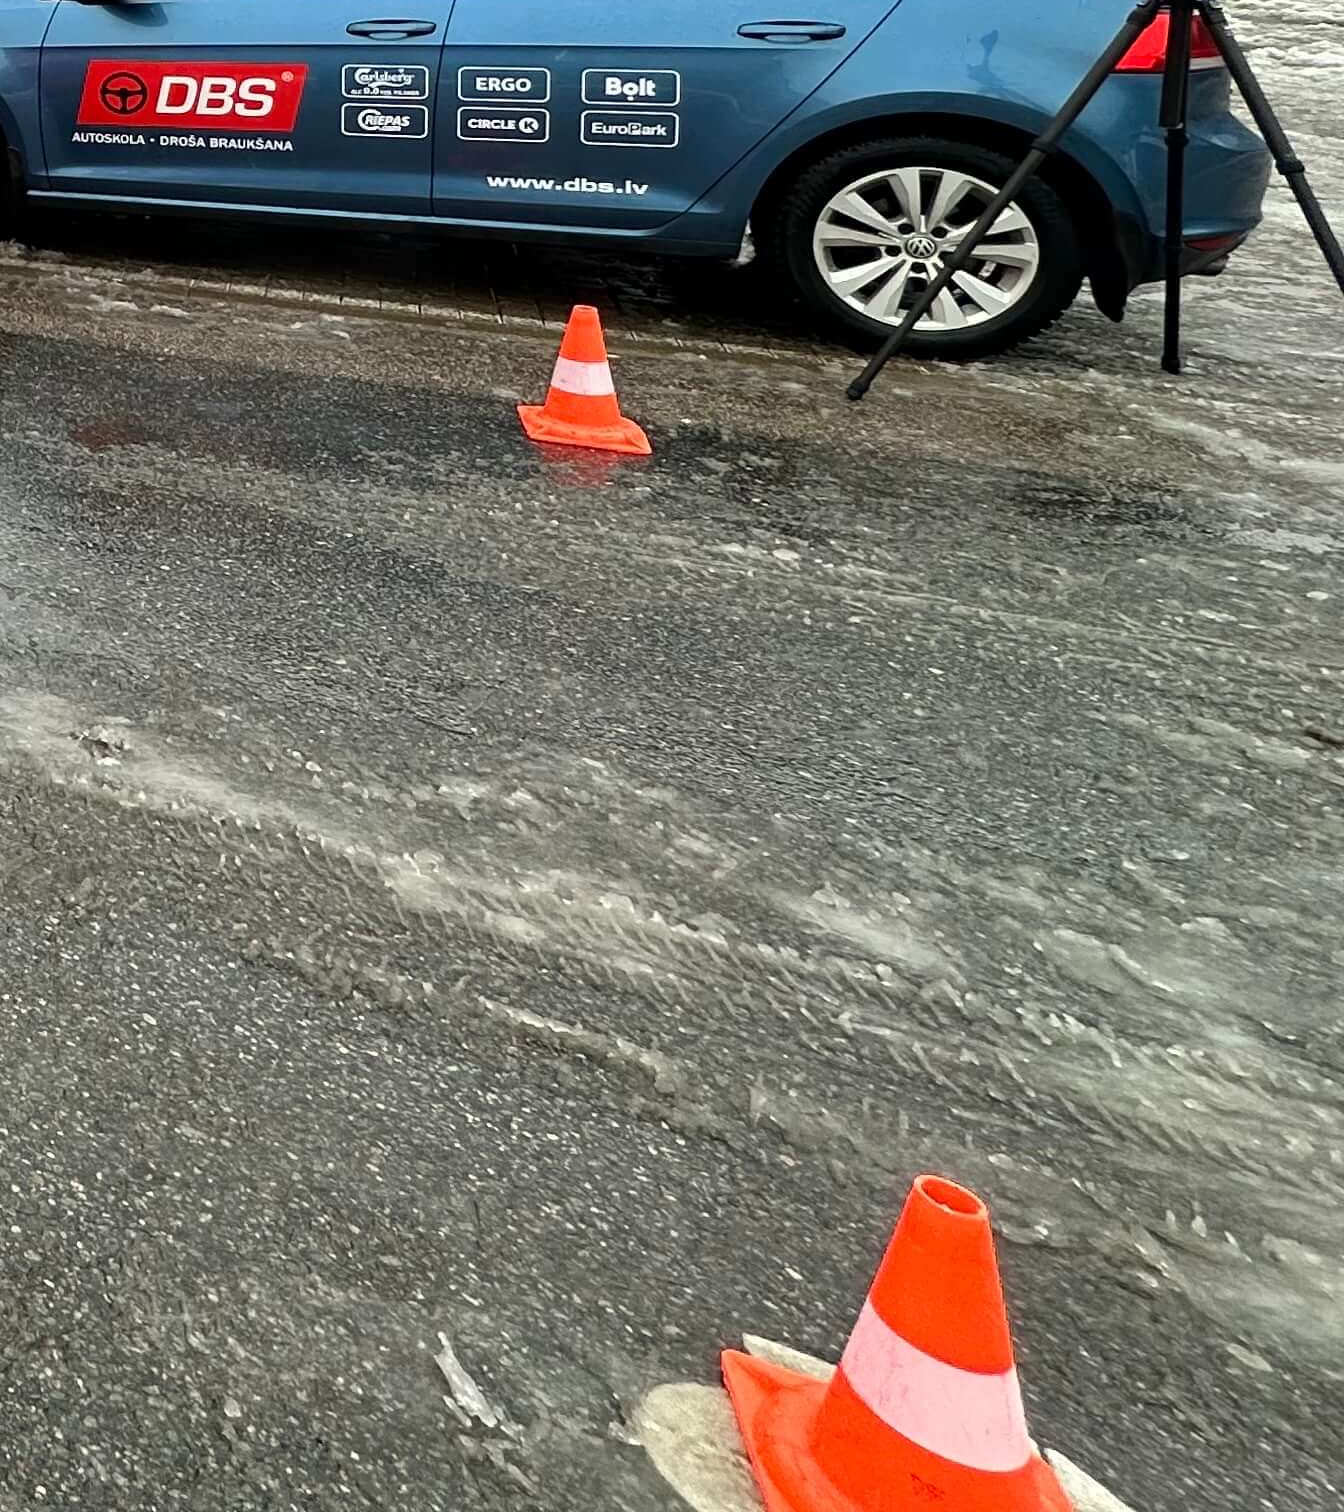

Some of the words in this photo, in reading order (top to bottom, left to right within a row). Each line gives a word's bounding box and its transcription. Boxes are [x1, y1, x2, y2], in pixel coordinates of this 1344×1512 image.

[475, 77, 532, 92] ERGO
[604, 76, 657, 101] Bolt
[155, 75, 277, 117] DBS
[467, 119, 516, 130] CIRCLE
[521, 119, 538, 132] K
[591, 122, 667, 136] EuroPark
[72, 131, 146, 145] AUTOSKOLA
[159, 134, 206, 149] DROŠA
[209, 135, 294, 151] BRAUKŠANA
[487, 176, 649, 195] www.dbs.lv
